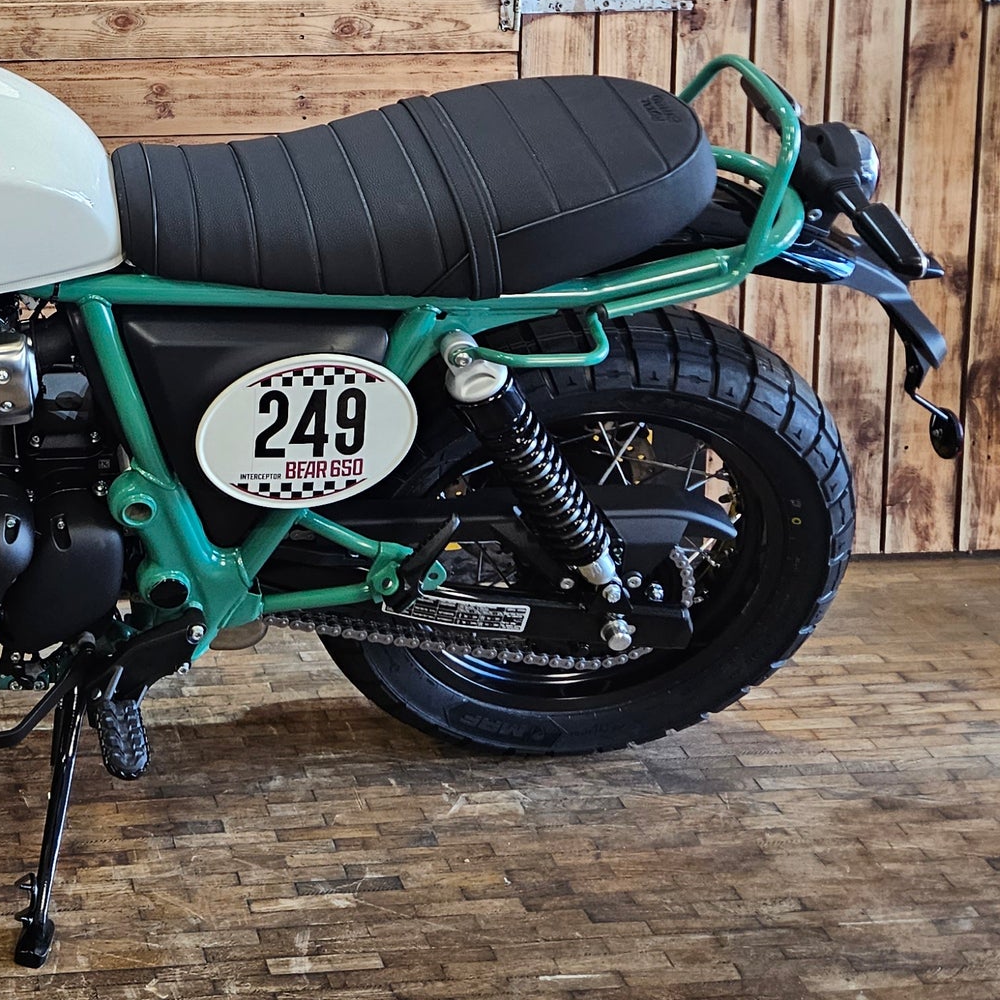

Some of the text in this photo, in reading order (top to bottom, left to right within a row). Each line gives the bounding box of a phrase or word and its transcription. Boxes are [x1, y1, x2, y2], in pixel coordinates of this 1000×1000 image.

[255, 387, 367, 458] 249
[285, 460, 327, 479] BEAR
[330, 458, 363, 477] 650
